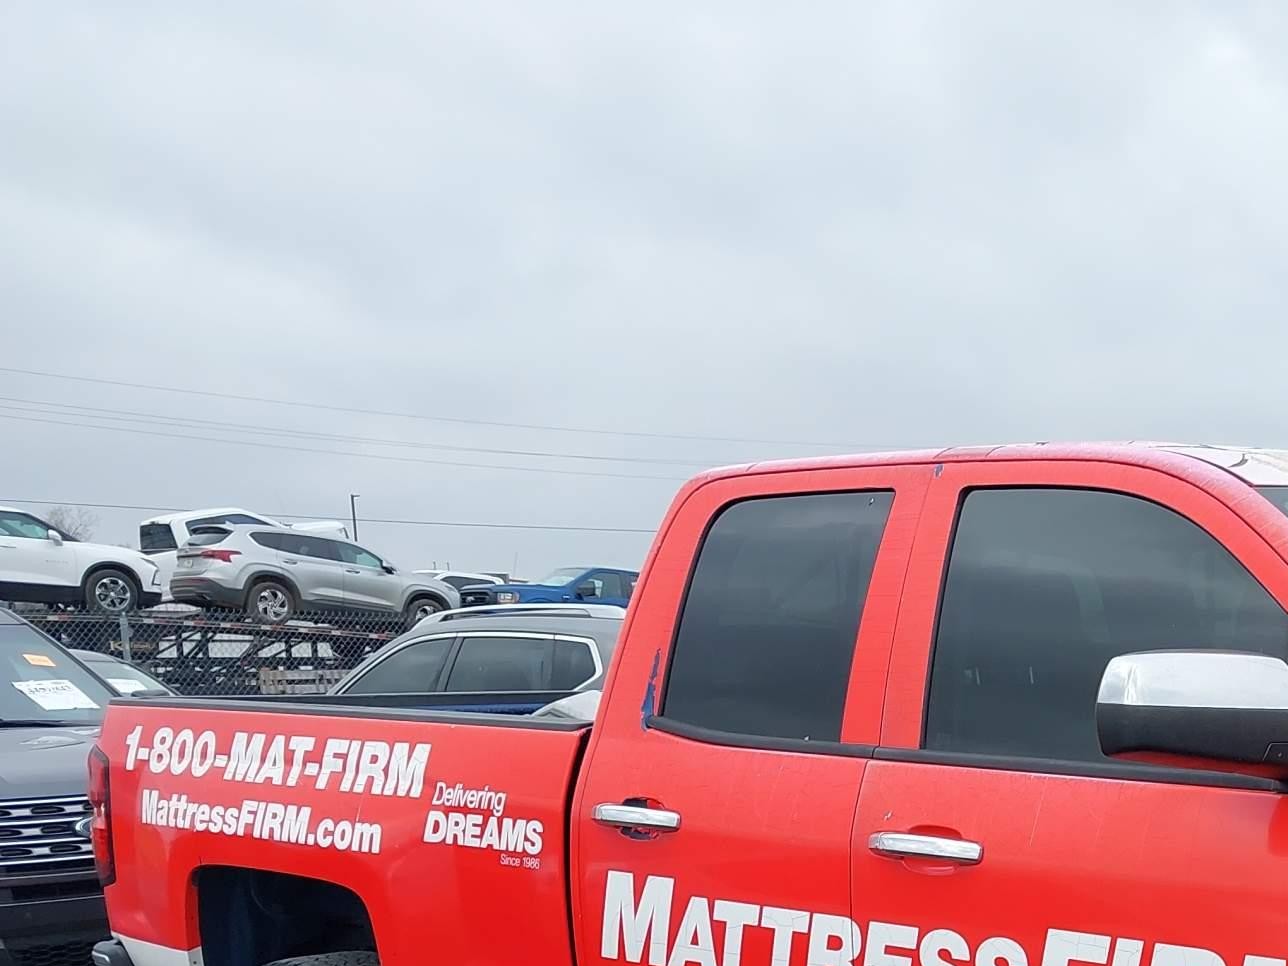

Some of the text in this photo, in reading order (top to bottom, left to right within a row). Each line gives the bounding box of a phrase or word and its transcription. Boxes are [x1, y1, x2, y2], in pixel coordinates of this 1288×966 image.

[125, 725, 432, 798] 1-800-MAT-FIRM
[141, 789, 382, 854] MattressFIRM.com
[432, 782, 507, 816] Delivering
[423, 810, 543, 855] DREAMS
[500, 854, 540, 869] Since 1986
